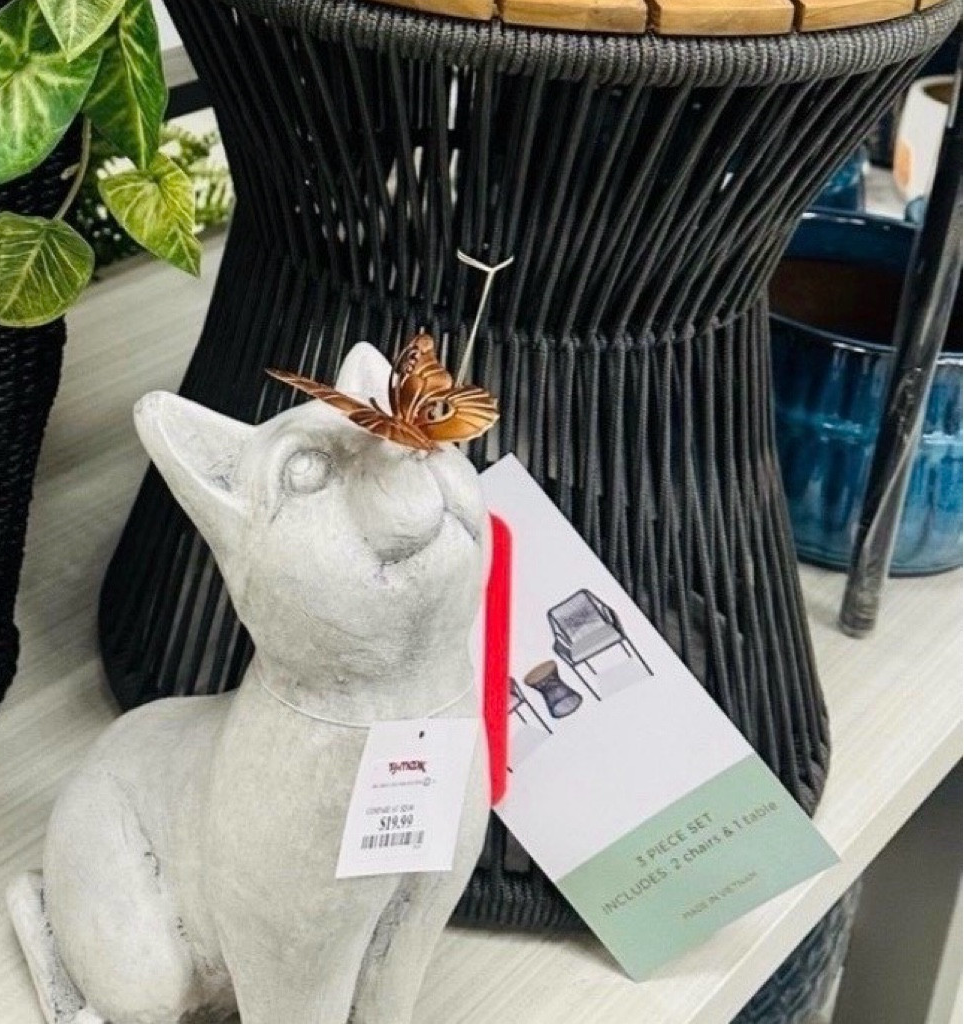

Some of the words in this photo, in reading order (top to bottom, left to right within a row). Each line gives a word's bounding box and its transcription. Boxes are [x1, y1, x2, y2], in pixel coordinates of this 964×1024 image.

[378, 815, 413, 830] $19.99
[636, 855, 648, 868] 3
[646, 829, 686, 860] PIECE
[687, 812, 713, 834] SET
[670, 857, 682, 870] 2
[683, 835, 722, 863] chairs
[723, 826, 734, 838] &
[733, 819, 742, 829] 1
[742, 801, 779, 826] table
[682, 901, 709, 919] MADE
[709, 893, 721, 905] IN
[721, 871, 758, 898] VIETNAM
